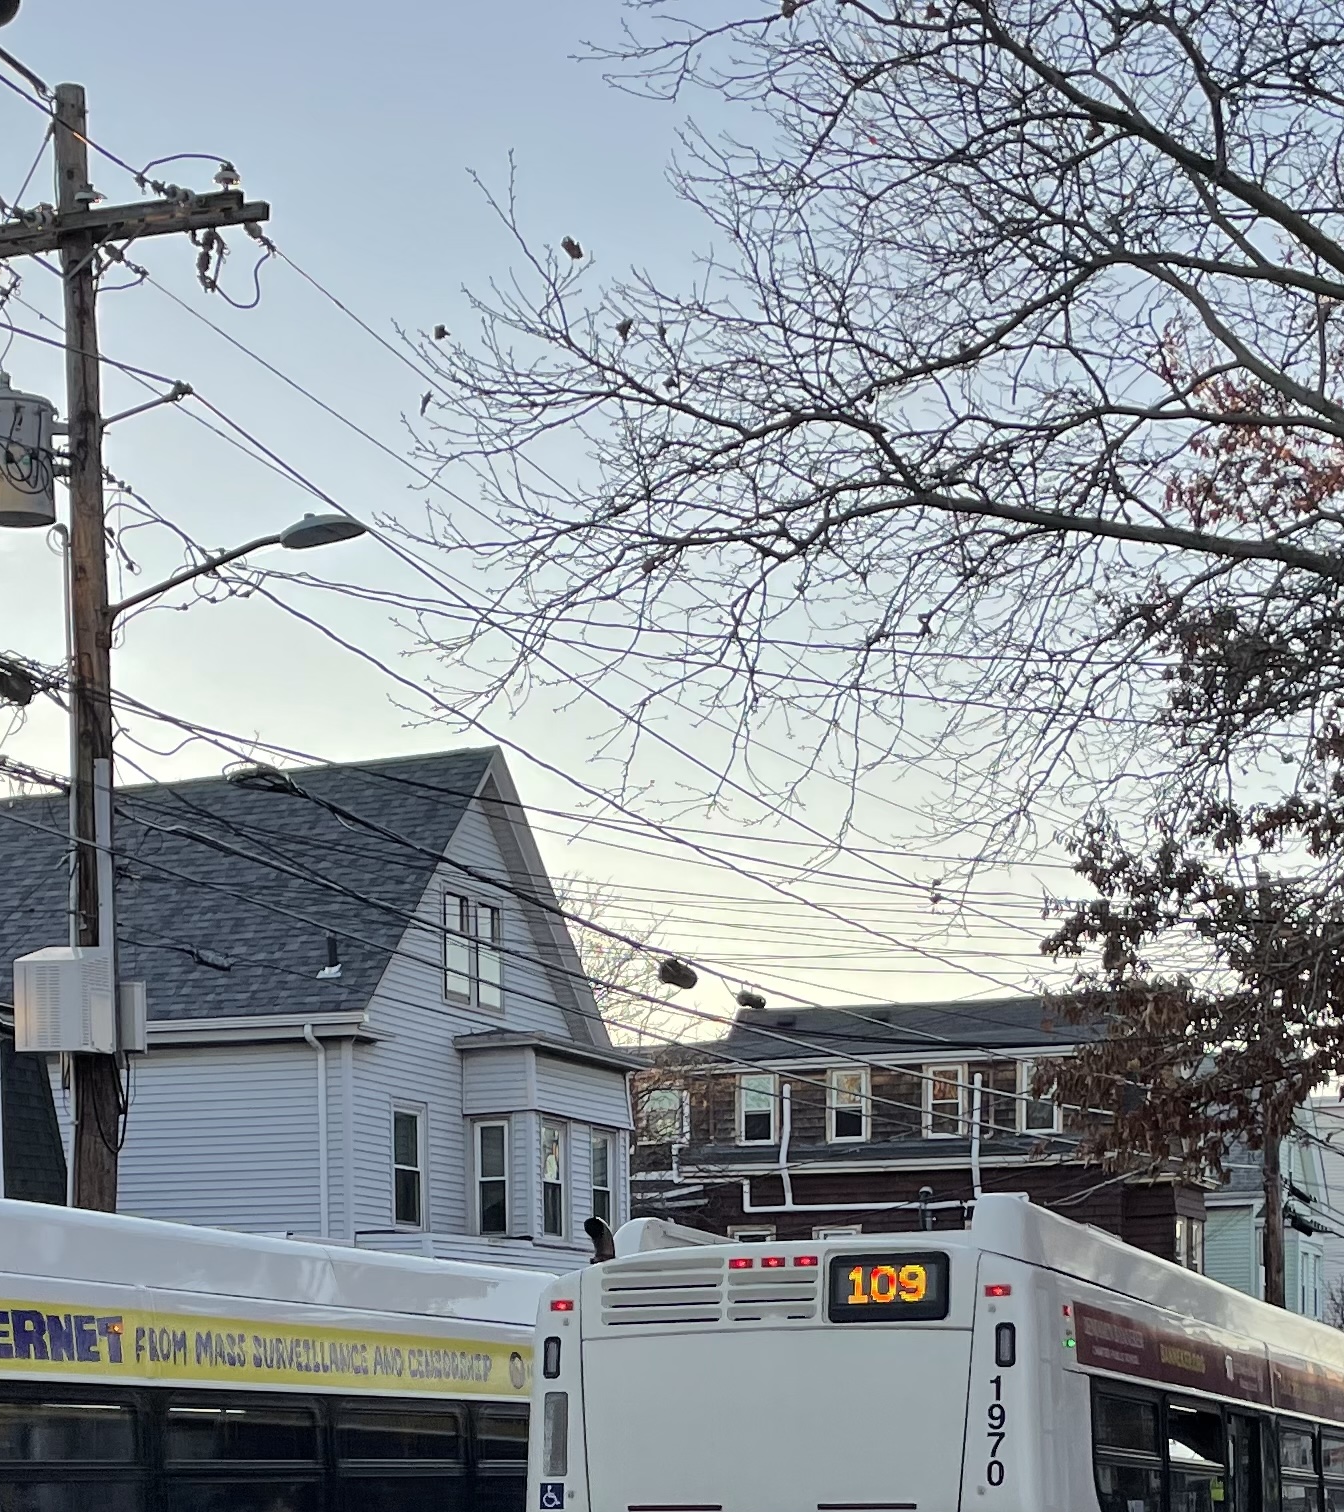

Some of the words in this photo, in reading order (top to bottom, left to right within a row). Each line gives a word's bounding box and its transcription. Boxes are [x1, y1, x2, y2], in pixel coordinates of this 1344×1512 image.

[847, 1264, 927, 1304] 109
[136, 1326, 187, 1366] FROM
[195, 1330, 247, 1368] MASS
[252, 1335, 369, 1375] SURVEILLANCE
[373, 1345, 403, 1377] AND
[986, 1374, 1007, 1487] 1970
